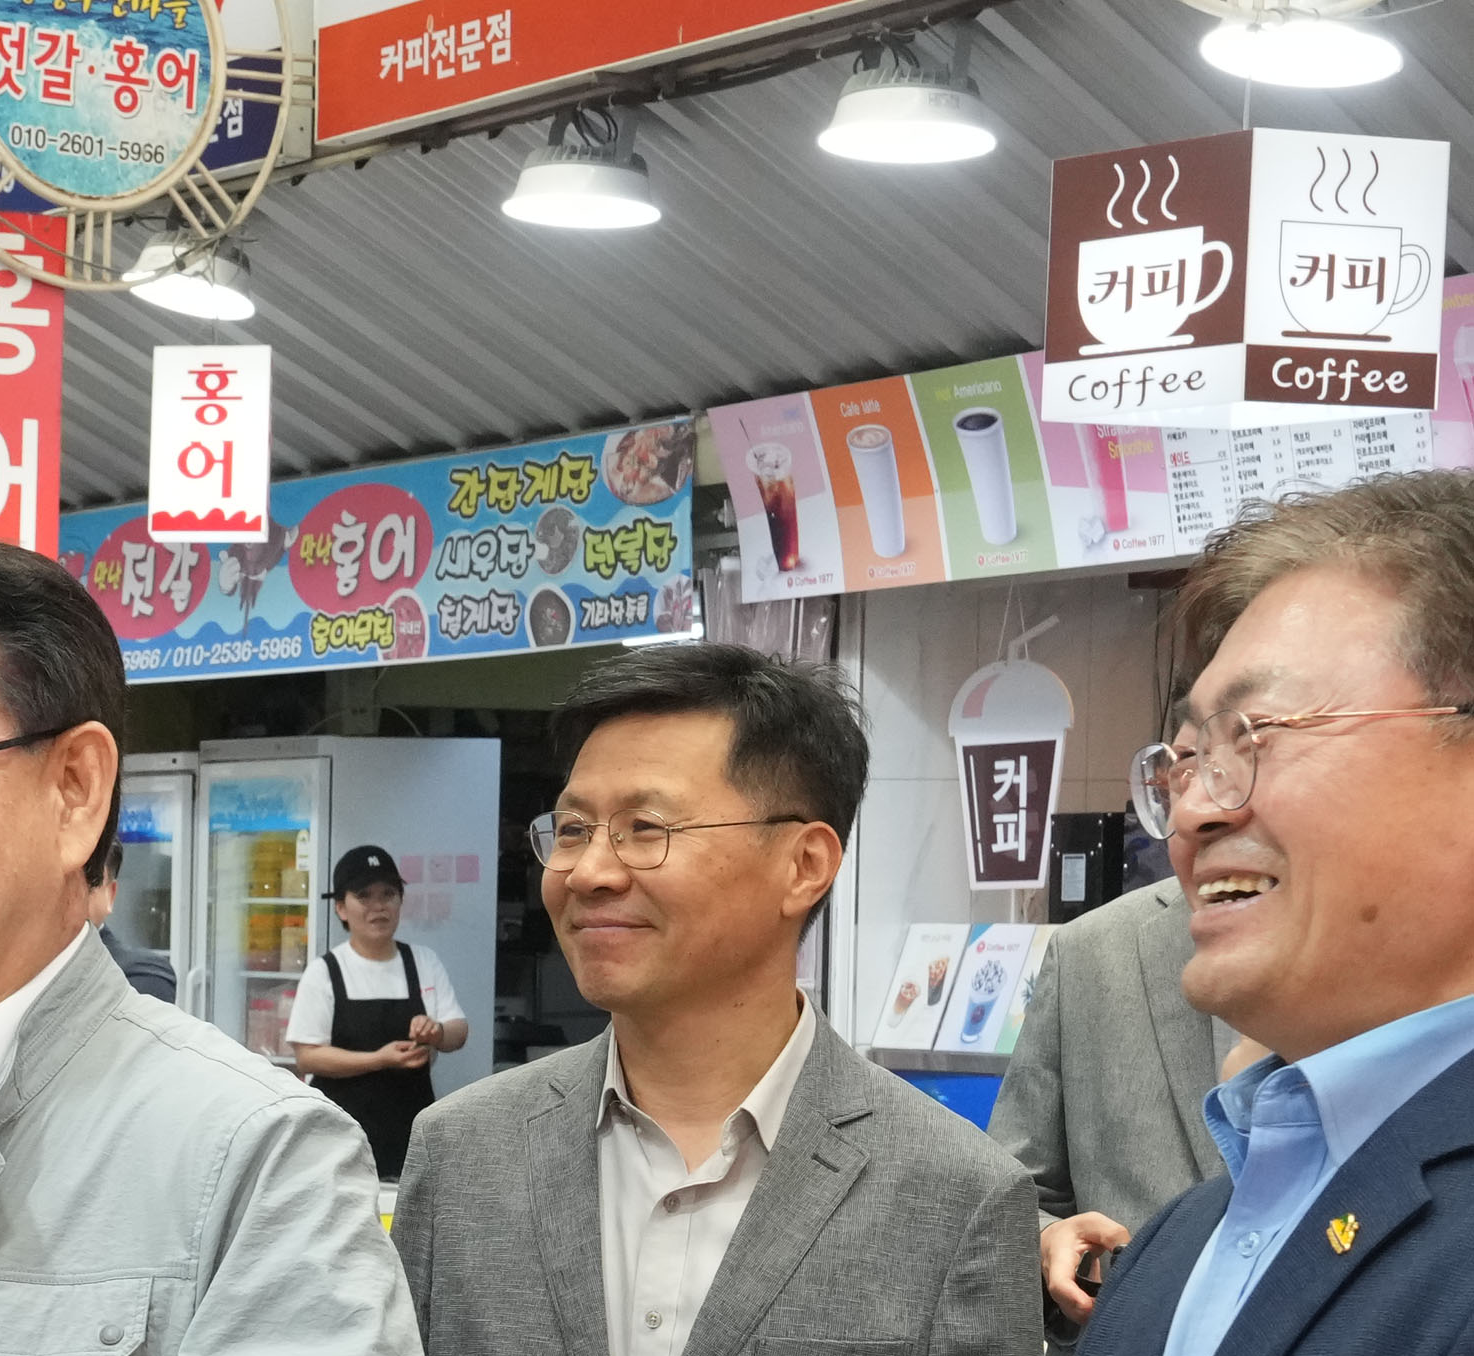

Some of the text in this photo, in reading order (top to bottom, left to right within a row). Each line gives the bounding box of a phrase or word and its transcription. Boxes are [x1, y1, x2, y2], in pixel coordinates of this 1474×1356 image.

[378, 9, 513, 82] 커피전문점
[10, 124, 166, 165] 010-2601-5966
[1087, 257, 1187, 313] 커피
[1288, 252, 1388, 305] 커피
[1067, 366, 1207, 409] Coffee
[1271, 355, 1409, 403] Coffee
[176, 363, 243, 499] 홍어
[1170, 451, 1192, 467] 에이드
[448, 451, 599, 519] 간장게장
[332, 509, 416, 598] 홍어
[435, 516, 678, 582] 새우장 전복장
[985, 553, 1009, 565] Coffee
[1121, 535, 1166, 550] Coffee 1977
[121, 540, 200, 619] 젓갈
[794, 572, 834, 588] Coffee 1977
[172, 635, 302, 668] 010-2536-5966
[311, 606, 396, 656] 홍어무침
[991, 754, 1029, 863] 커피
